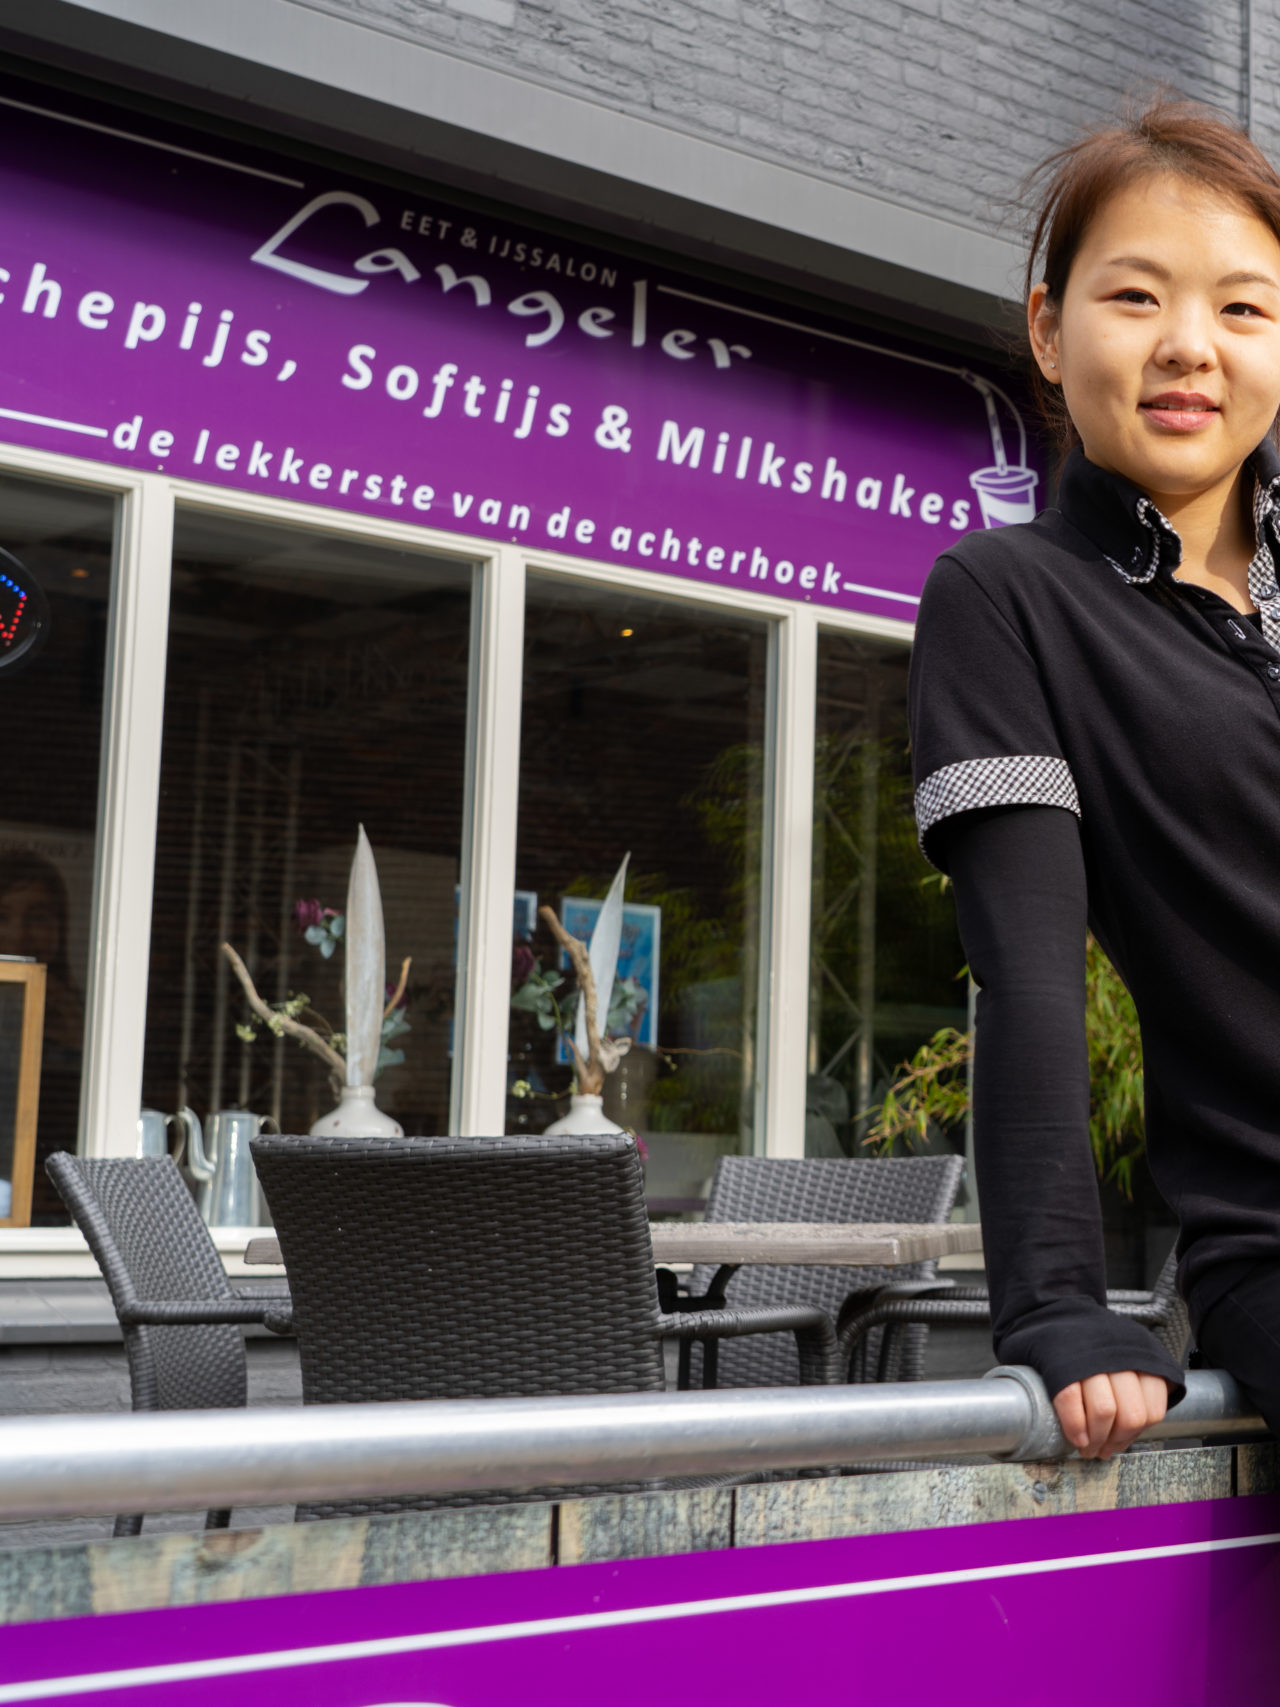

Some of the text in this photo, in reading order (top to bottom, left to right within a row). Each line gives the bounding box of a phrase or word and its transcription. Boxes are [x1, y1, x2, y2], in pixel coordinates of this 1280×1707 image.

[250, 190, 753, 369] Langeler
[401, 210, 618, 289] EET & IJSSALON
[0, 262, 971, 531] hepijs, Softijs & Milkshakes
[113, 415, 840, 594] de lekkerste van de achterhoek
